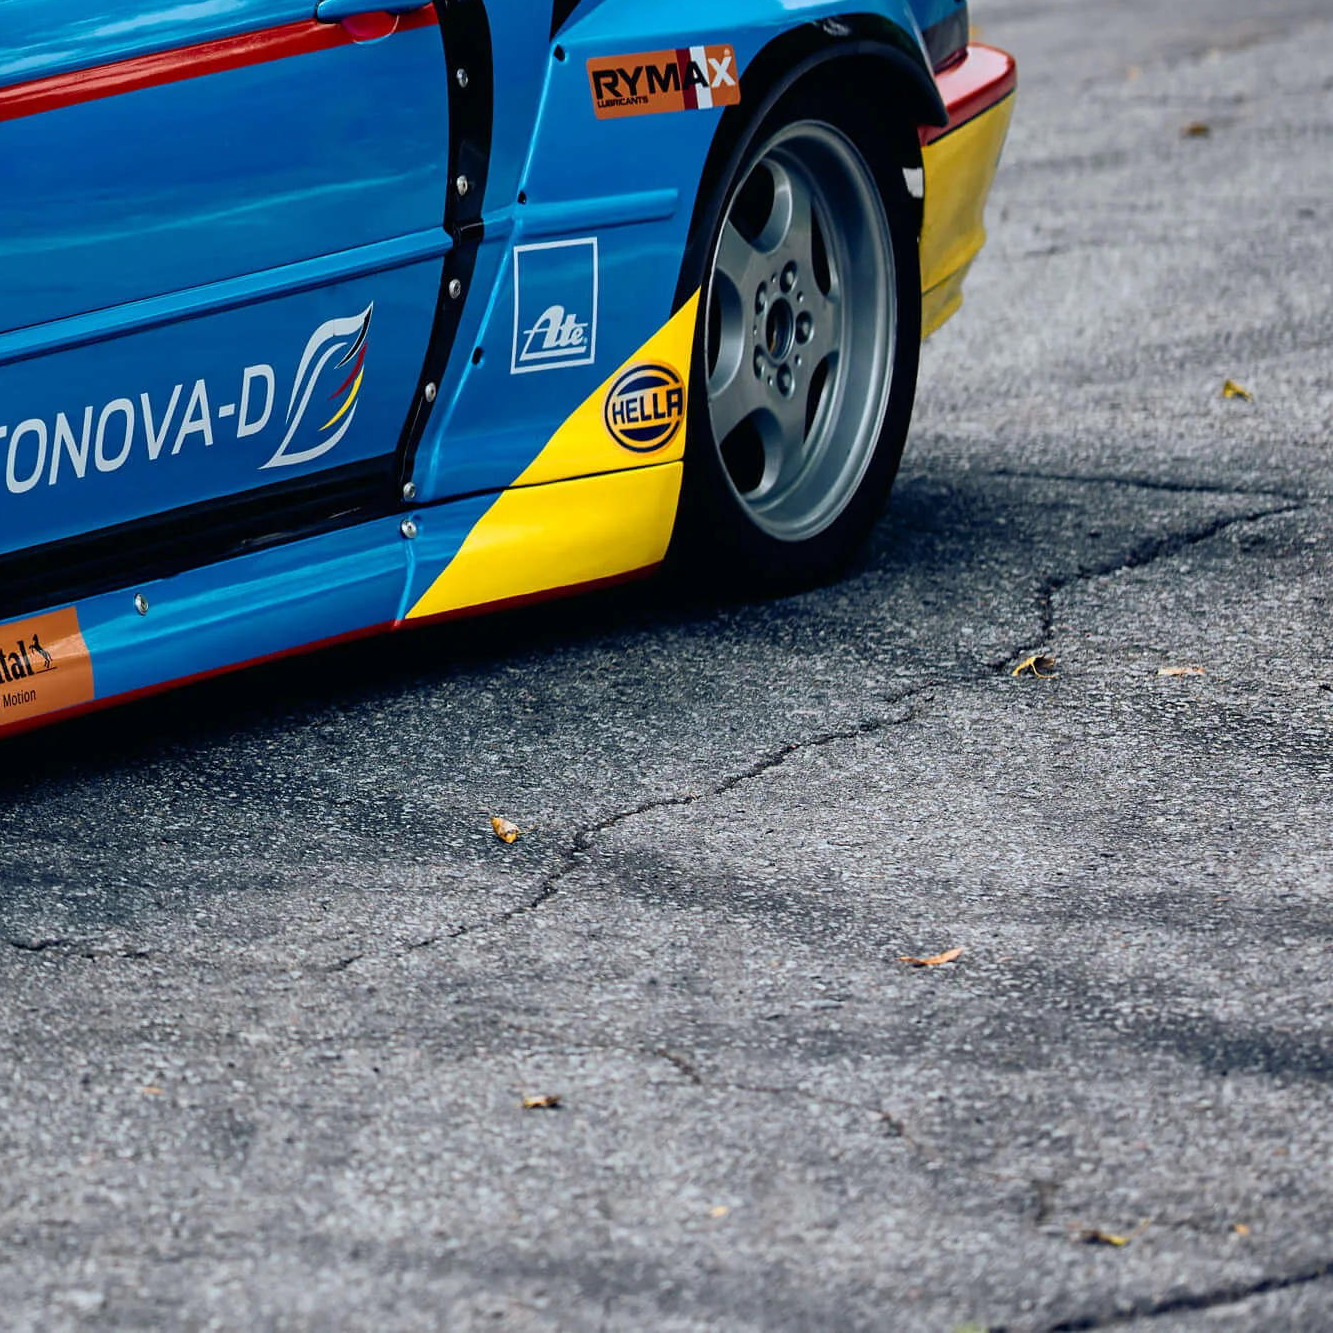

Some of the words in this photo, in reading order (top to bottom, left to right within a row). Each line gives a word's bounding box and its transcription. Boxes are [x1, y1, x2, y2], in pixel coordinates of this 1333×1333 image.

[592, 56, 736, 99] RYMAX
[597, 95, 649, 108] LUBRICANTS
[520, 305, 588, 356] Ate
[612, 387, 683, 426] HELLA
[3, 689, 36, 708] Motion
